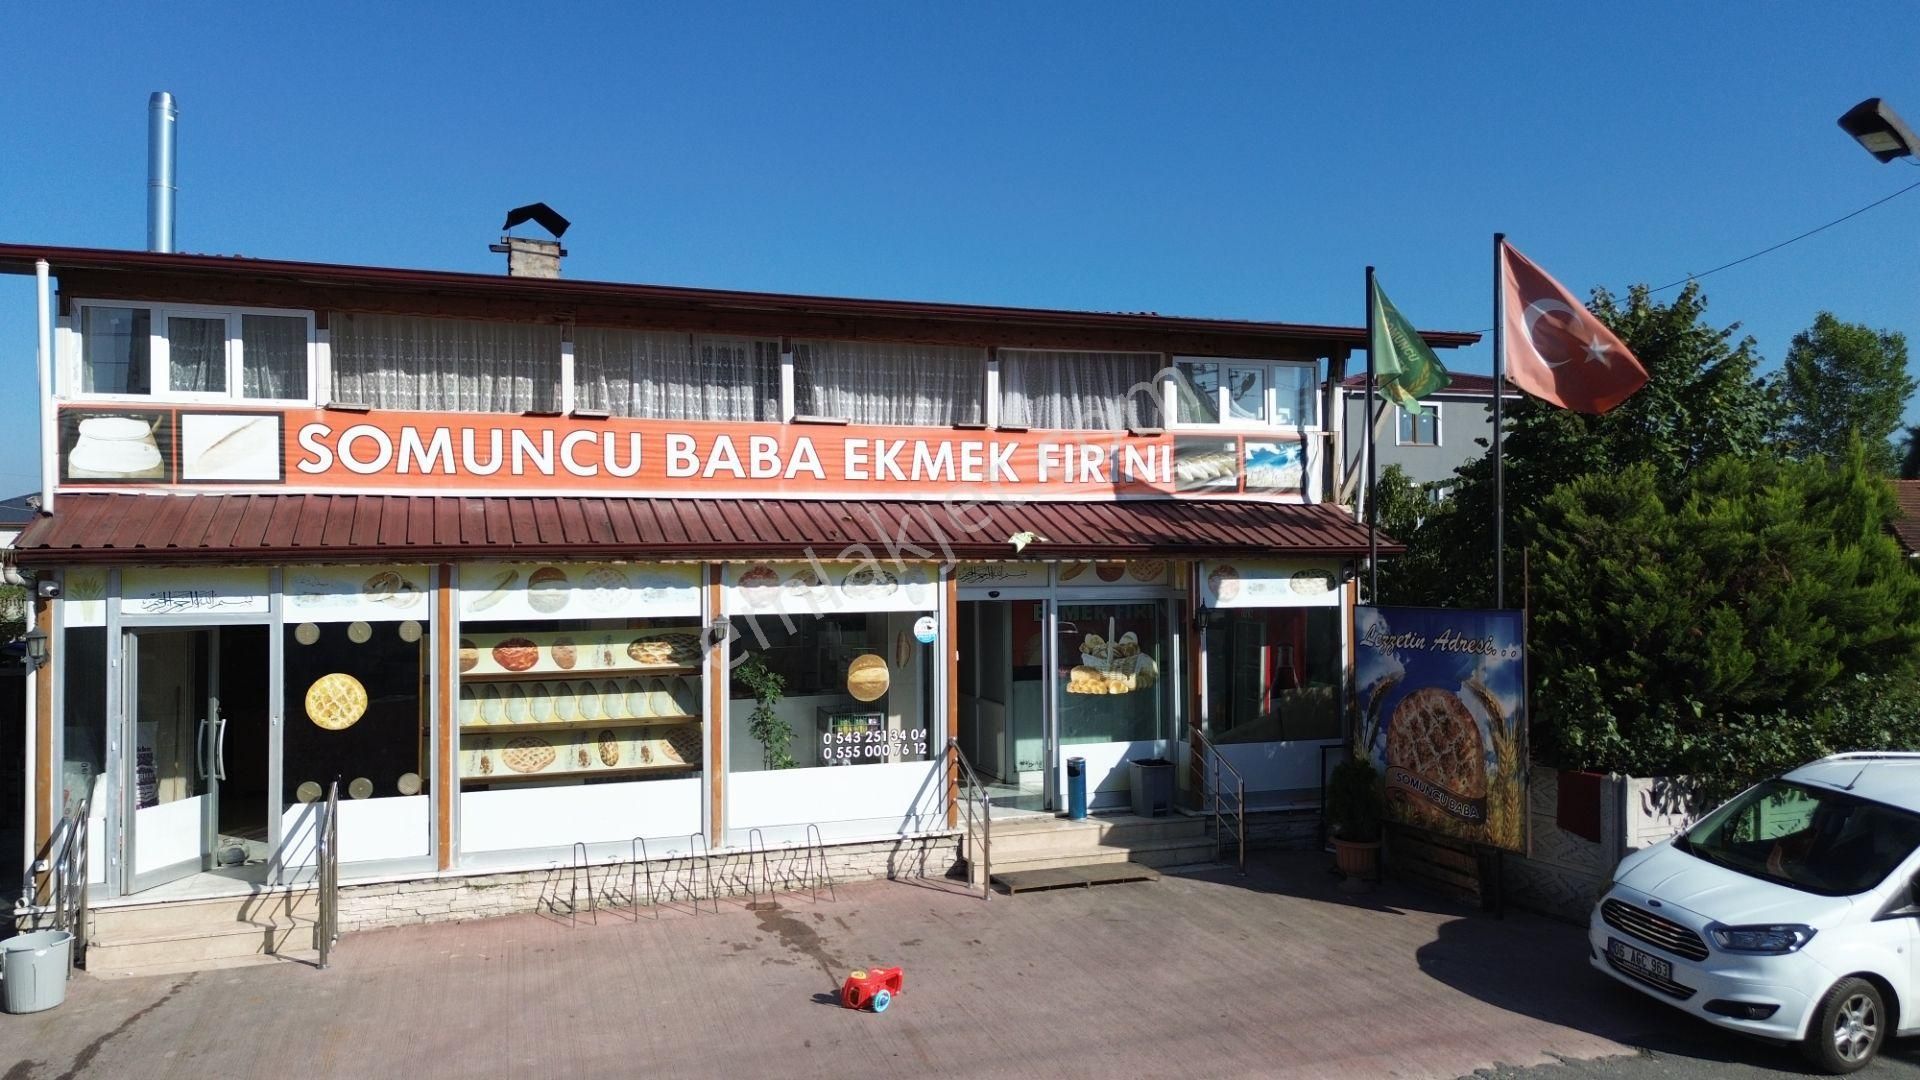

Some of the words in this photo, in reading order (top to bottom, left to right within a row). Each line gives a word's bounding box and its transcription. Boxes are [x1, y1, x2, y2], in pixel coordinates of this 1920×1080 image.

[297, 422, 642, 478] SOMUNCU
[665, 432, 826, 480] BABA
[844, 437, 1020, 483] EKMEK
[1037, 443, 1173, 483] FIRINI
[1360, 624, 1425, 656] Lezzetin
[823, 733, 832, 745] 0
[836, 731, 861, 744] 543
[865, 729, 887, 743] 251
[891, 729, 907, 741] 34
[911, 728, 927, 740] 04
[823, 747, 832, 760] 0
[836, 745, 861, 759] 555
[864, 744, 890, 758] 000
[894, 742, 909, 756] 76
[913, 742, 927, 755] 12
[1396, 773, 1448, 807] SOMUNCU
[1448, 801, 1479, 818] BABA
[1615, 943, 1625, 958] 06
[1651, 959, 1668, 977] 963
